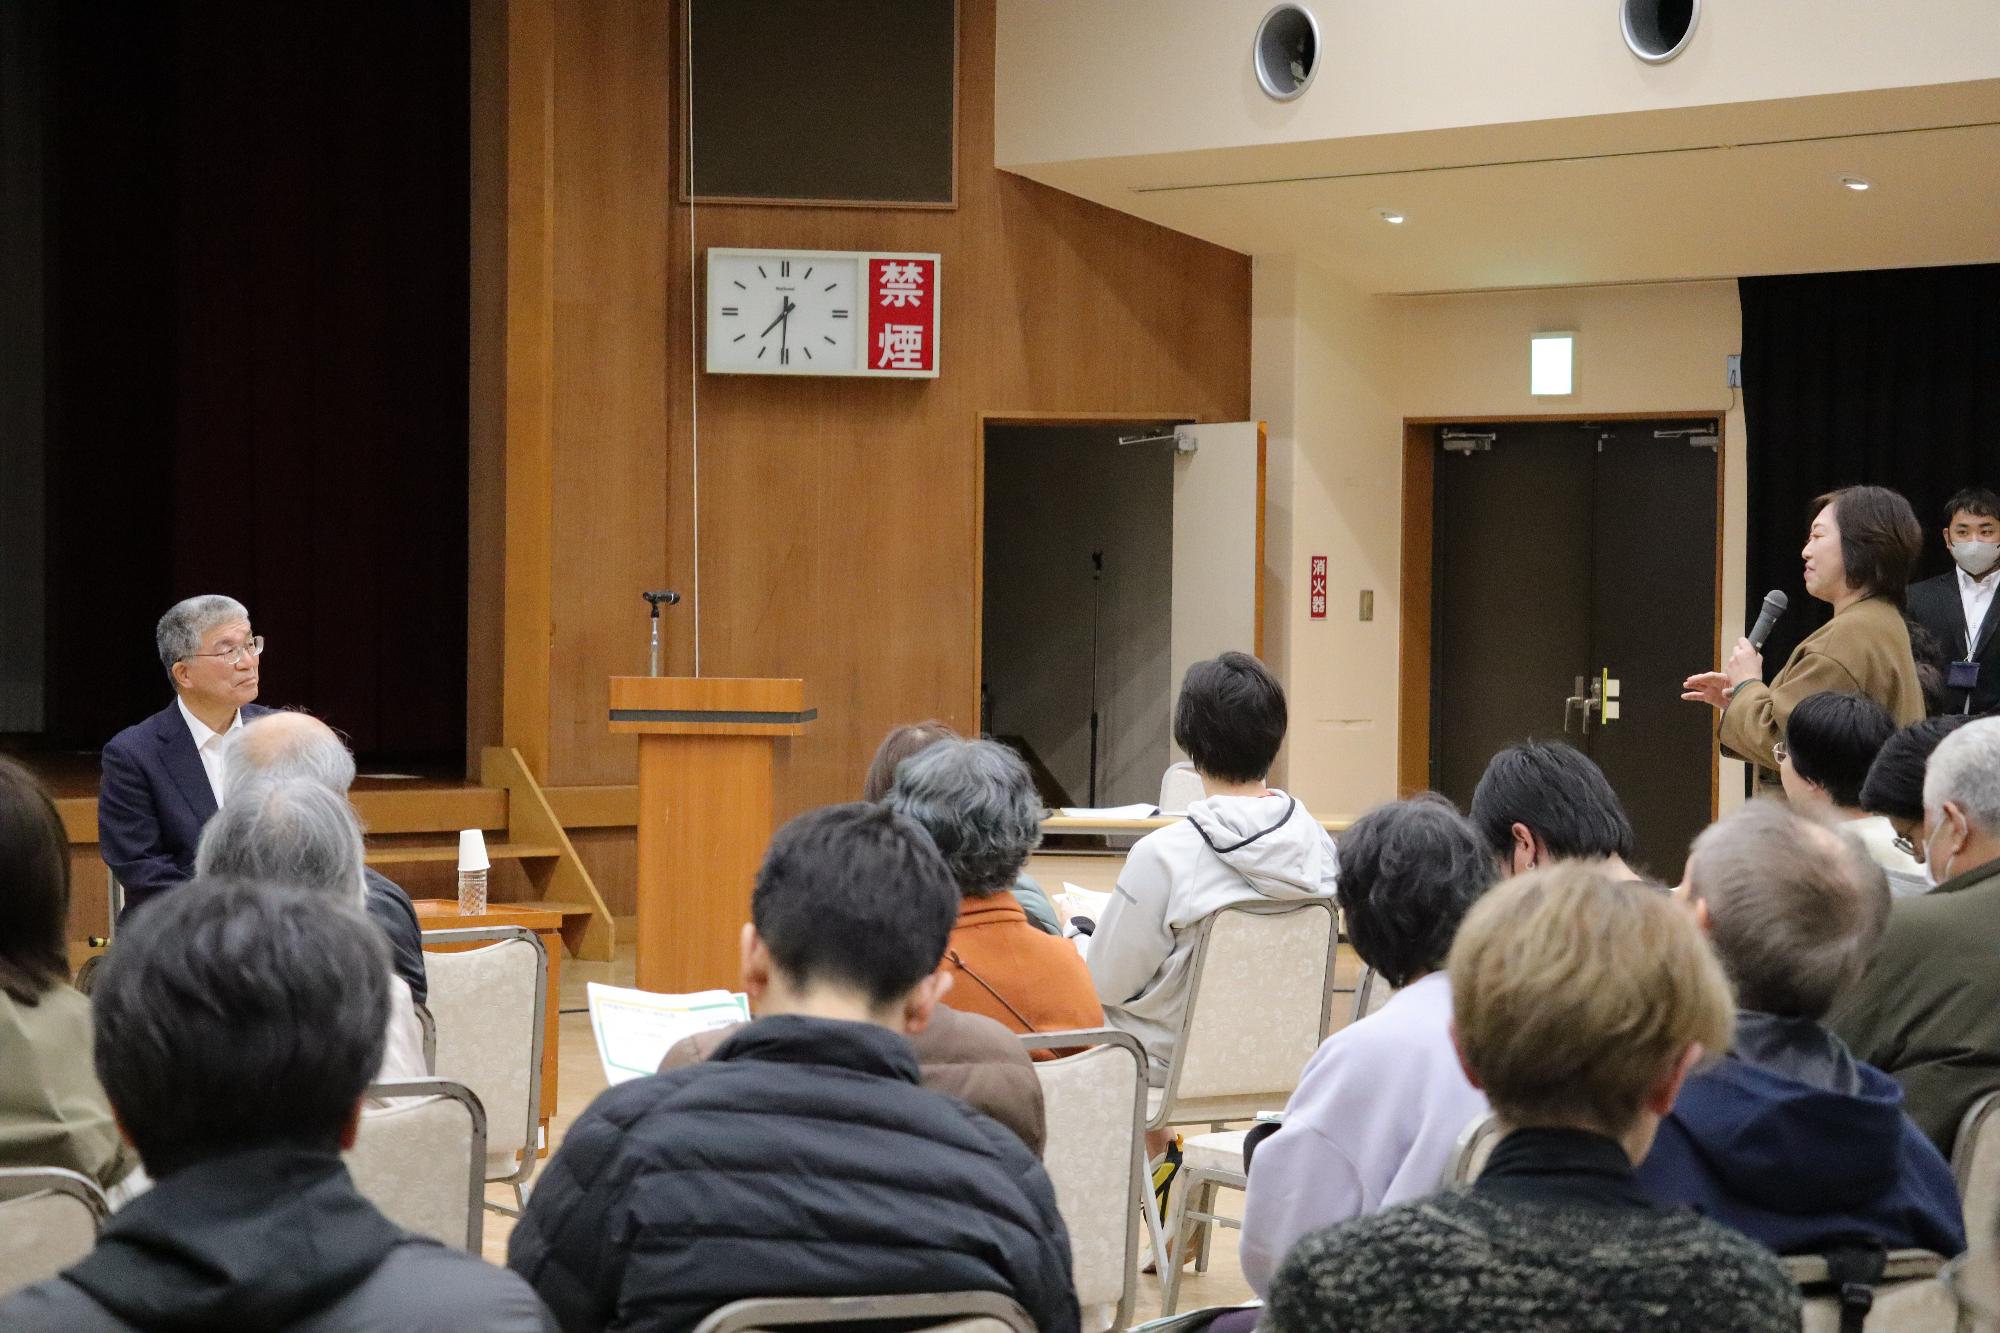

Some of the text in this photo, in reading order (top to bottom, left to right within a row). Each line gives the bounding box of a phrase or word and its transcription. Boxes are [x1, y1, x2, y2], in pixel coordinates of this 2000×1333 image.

[878, 262, 924, 369] 禁煙
[1312, 559, 1326, 613] 消火器
